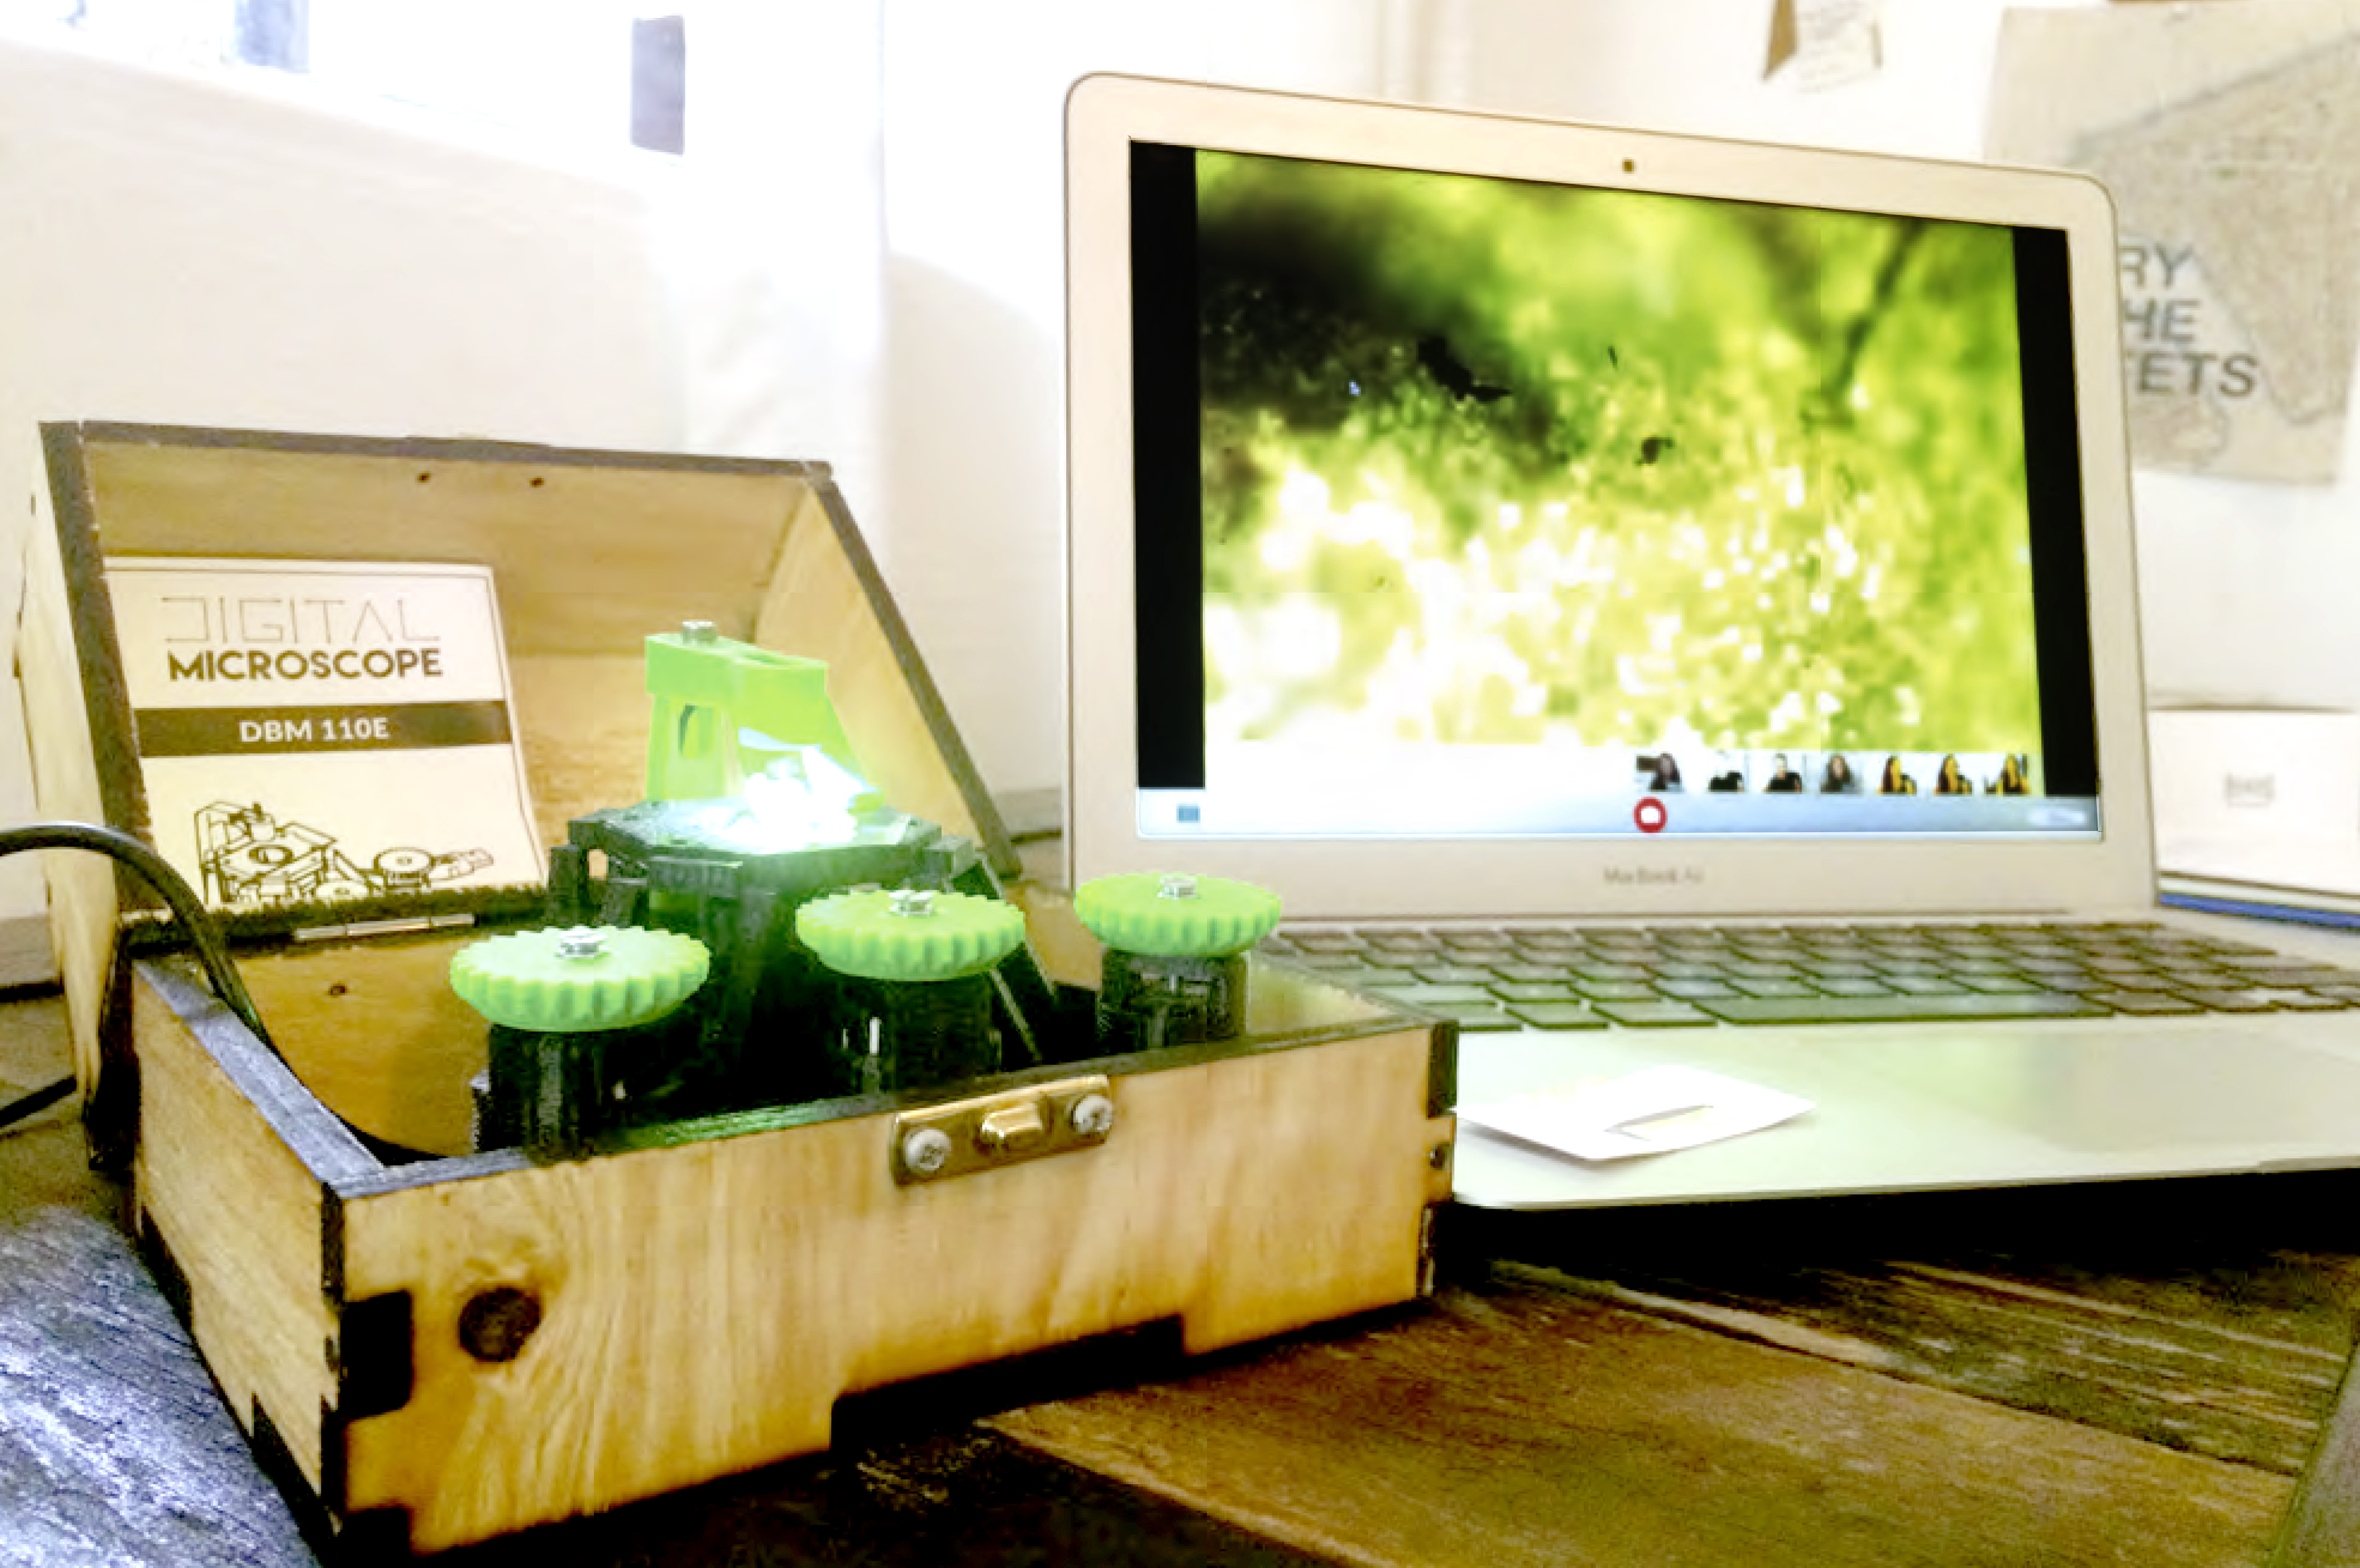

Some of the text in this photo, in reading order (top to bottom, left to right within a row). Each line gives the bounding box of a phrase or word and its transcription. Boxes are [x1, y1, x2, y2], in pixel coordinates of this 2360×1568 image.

[2124, 351, 2259, 398] ETS
[161, 596, 441, 643] DIGITAL
[168, 648, 443, 681] MICROSCOPE
[240, 717, 390, 742] DBM 110E
